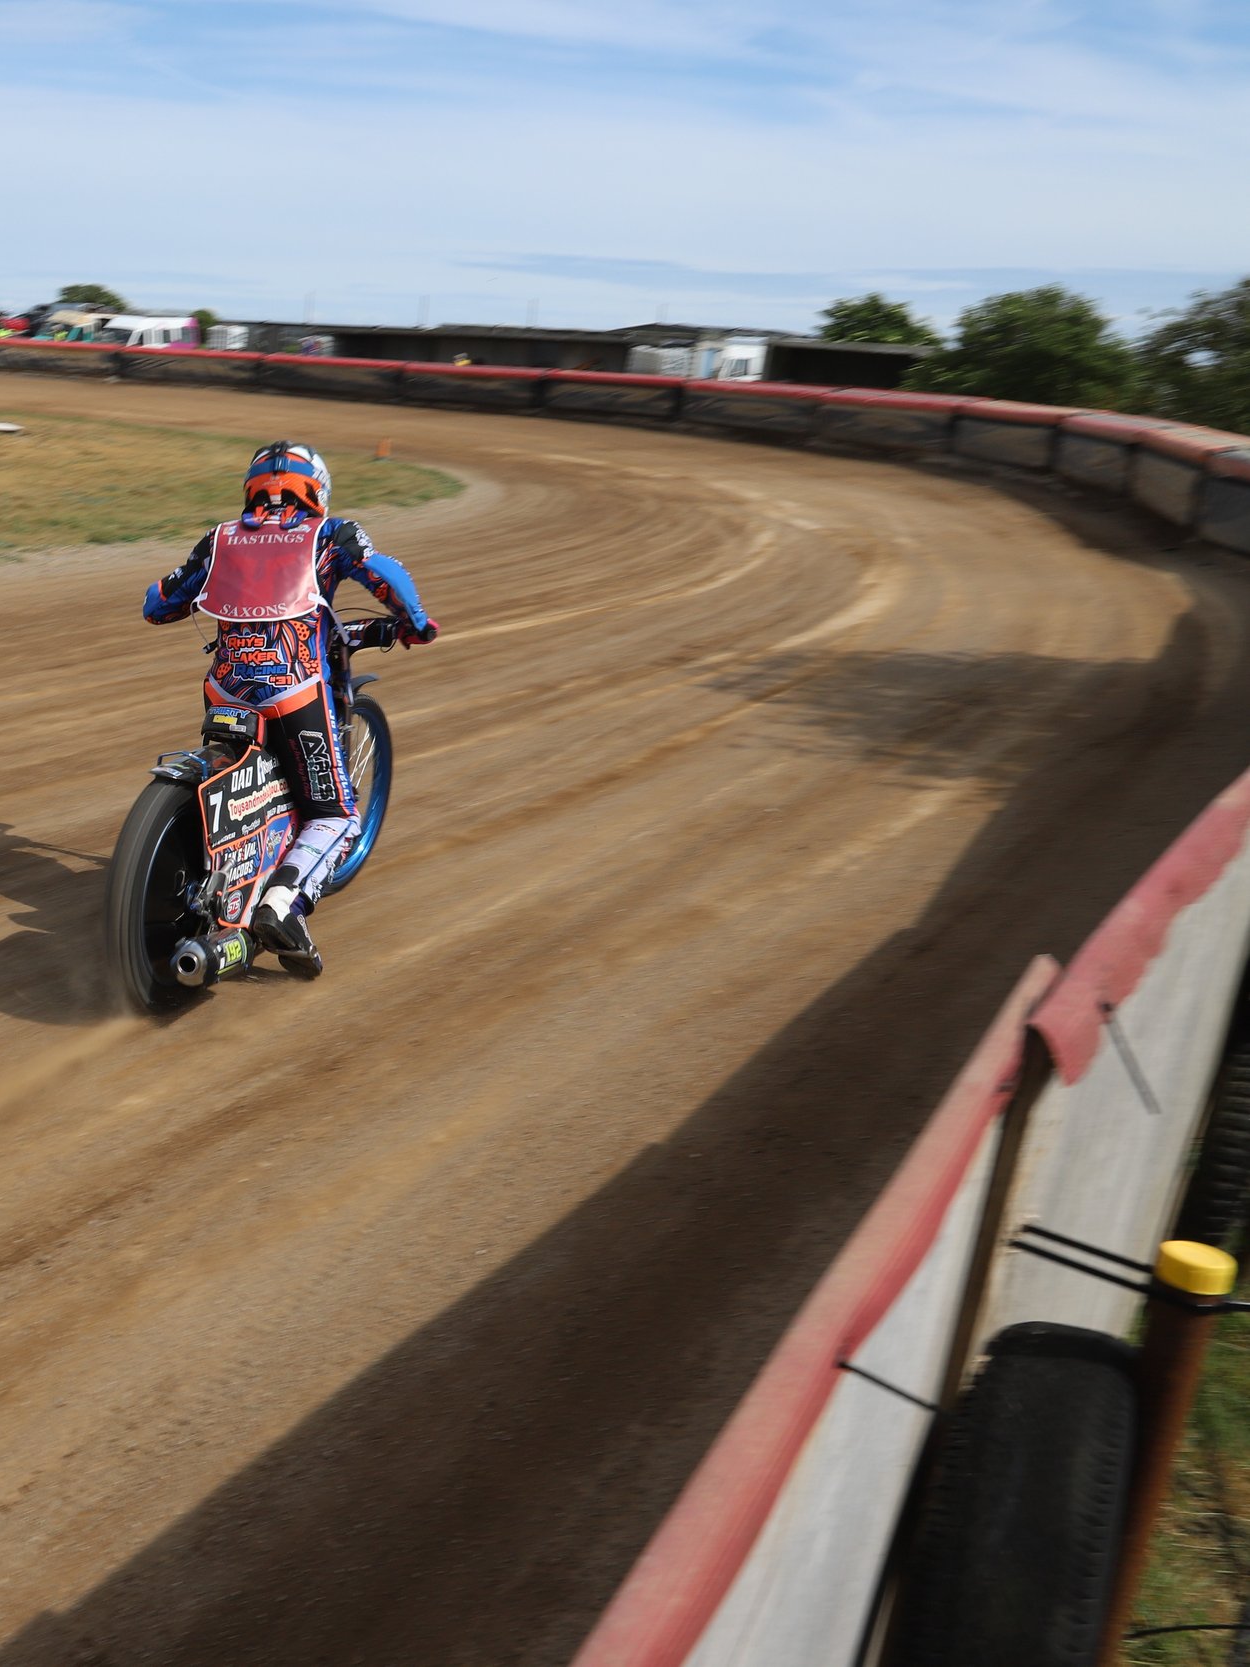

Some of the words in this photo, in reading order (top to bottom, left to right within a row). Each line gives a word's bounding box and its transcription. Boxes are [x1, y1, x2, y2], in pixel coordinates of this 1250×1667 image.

[227, 533, 305, 546] HASTINGS
[219, 602, 288, 618] SAXONS
[227, 635, 266, 651] RHYS
[230, 649, 282, 666] LAKER
[234, 664, 288, 679] RACING
[269, 674, 293, 685] #31
[209, 706, 251, 719] THIRTY
[231, 766, 254, 793] DAD
[209, 790, 223, 834] 7
[228, 859, 254, 883] JACOBS
